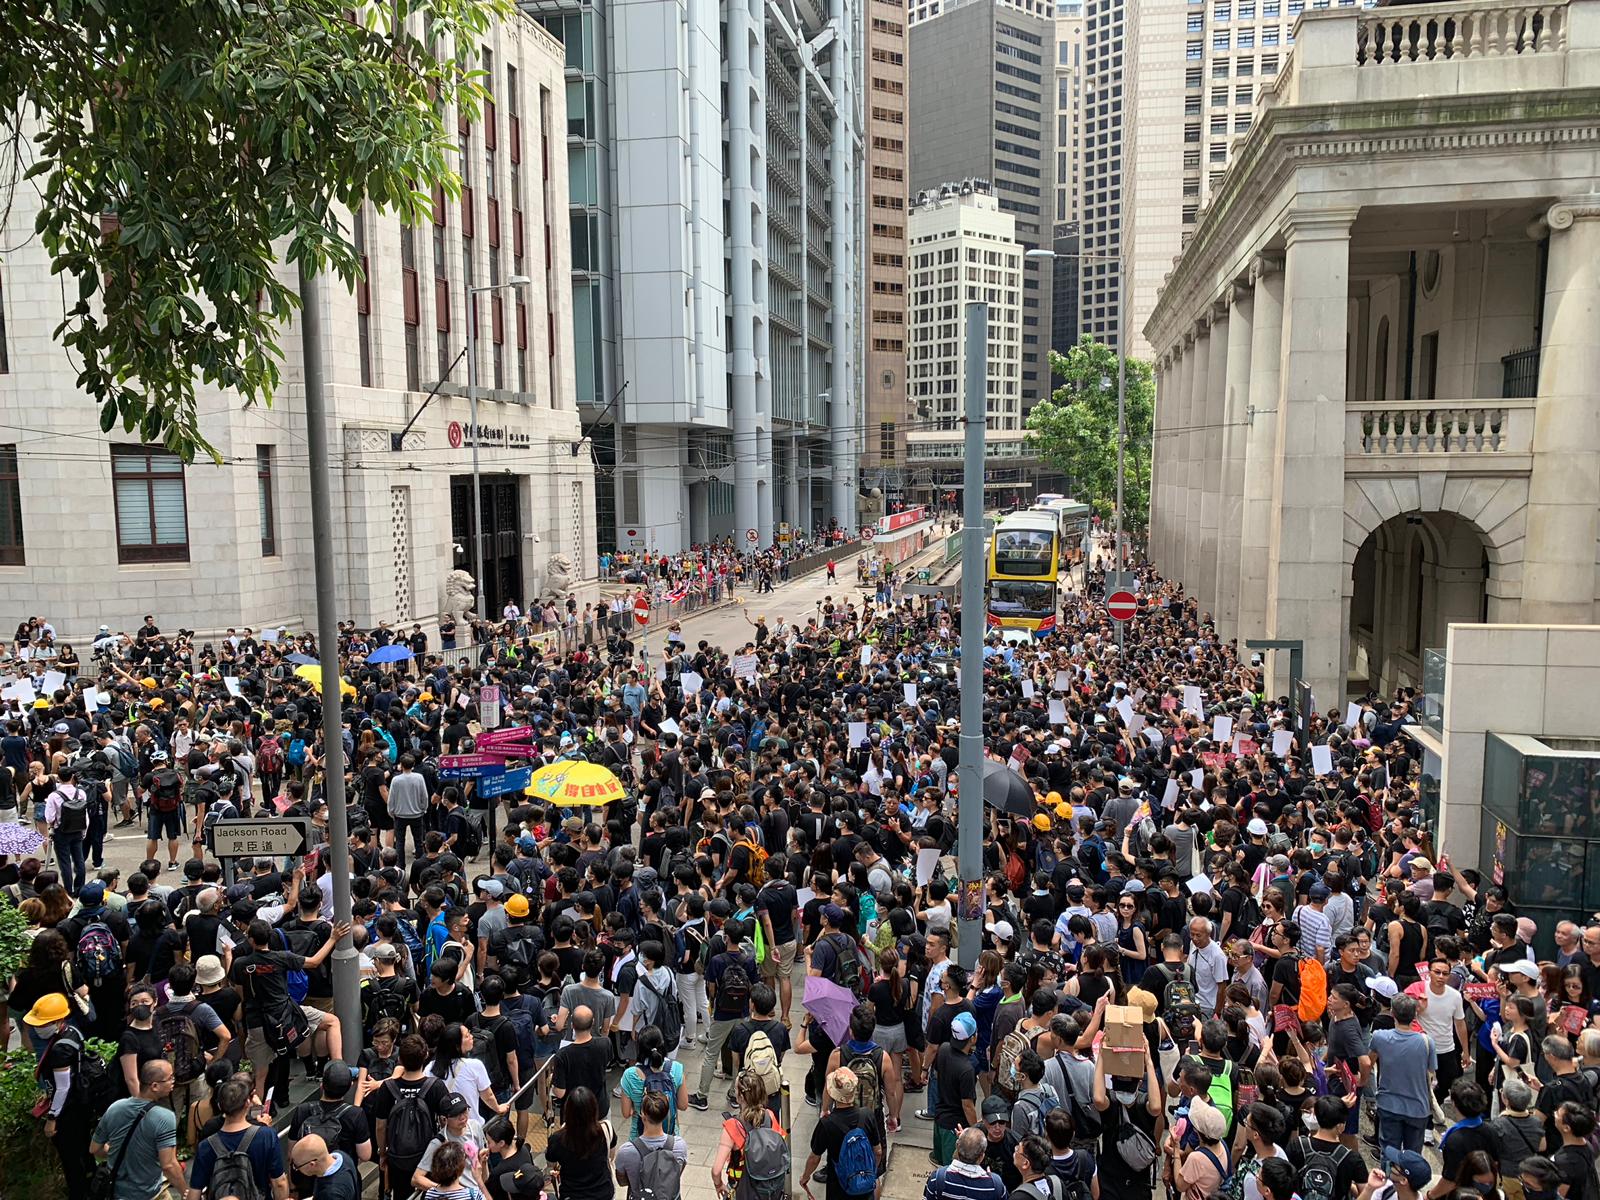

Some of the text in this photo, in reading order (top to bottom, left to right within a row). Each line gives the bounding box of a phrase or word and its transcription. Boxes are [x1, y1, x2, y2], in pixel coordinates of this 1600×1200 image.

[217, 827, 287, 837] Jackson Road
[232, 841, 274, 852] 昃臣道
